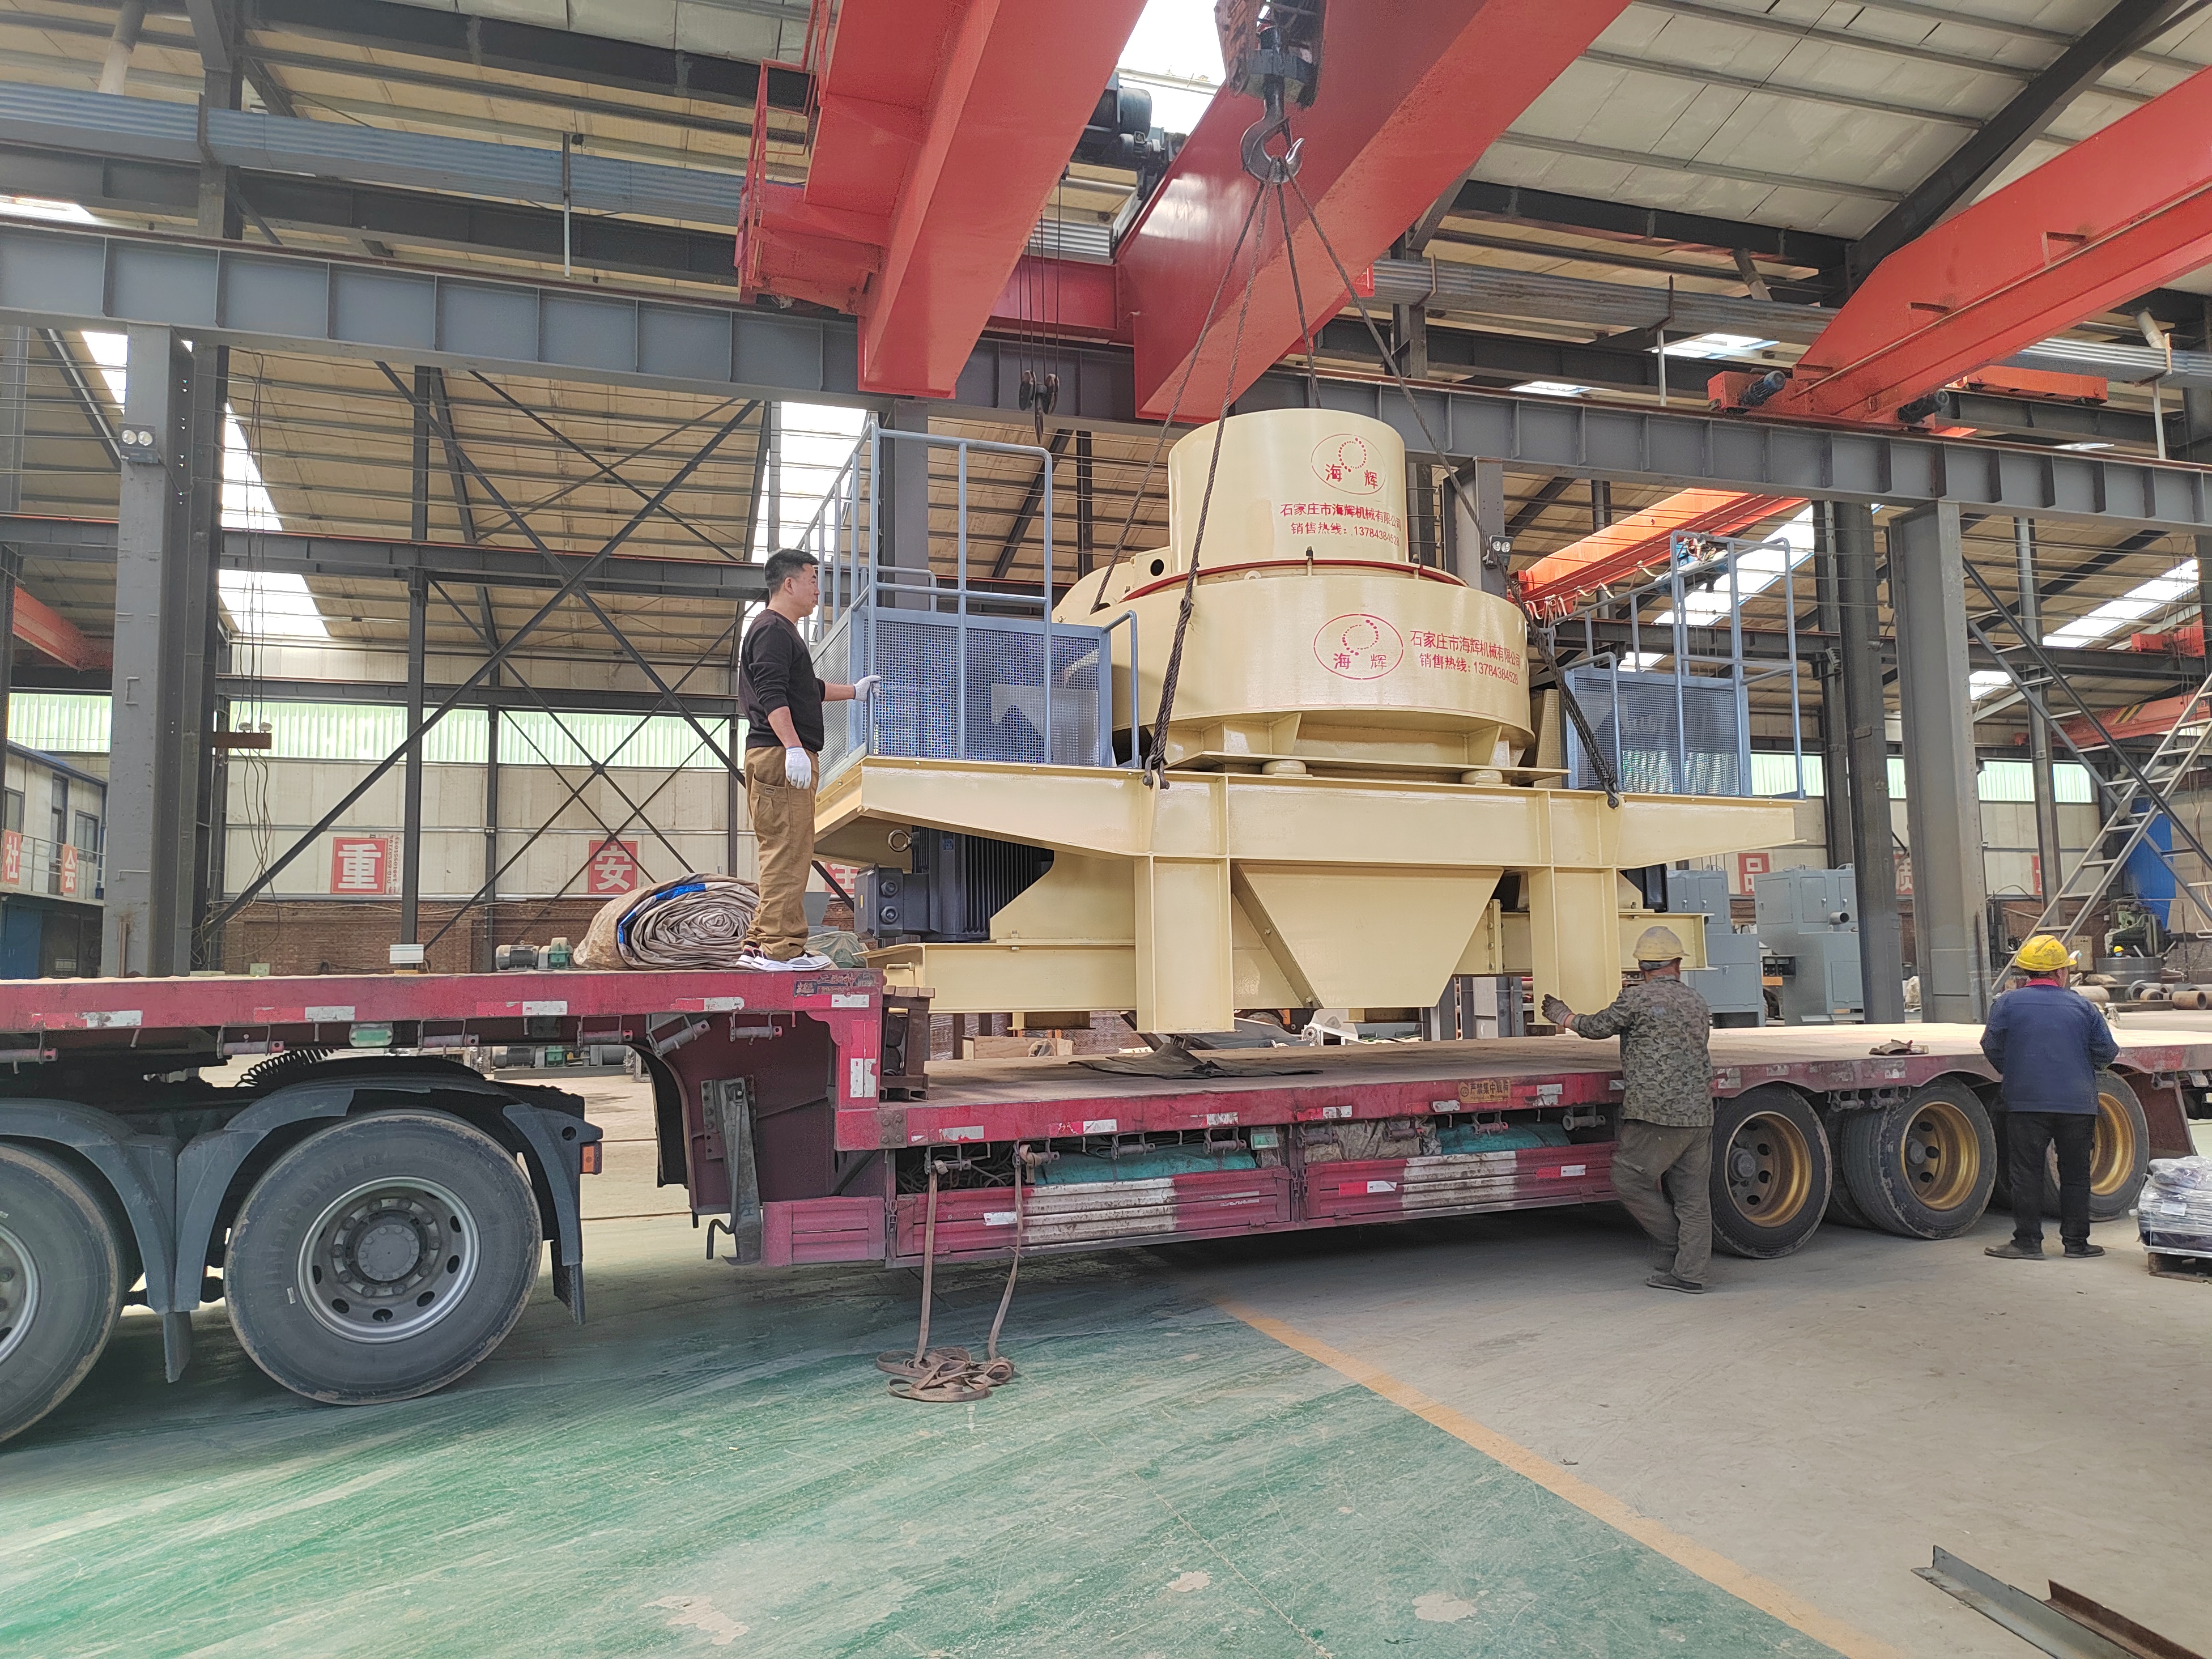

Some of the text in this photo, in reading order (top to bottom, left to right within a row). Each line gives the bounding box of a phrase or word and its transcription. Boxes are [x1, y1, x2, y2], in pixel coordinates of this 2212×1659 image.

[1325, 463, 1379, 489] 海 辉
[1280, 502, 1402, 531] 石家庄市海辉机械有限公司
[1333, 653, 1387, 670] 海 辉
[1409, 630, 1521, 667] 石家庄市海辉机械有限公司
[5, 836, 19, 880] 社
[65, 849, 76, 890] 会
[338, 843, 381, 890] 重
[594, 845, 632, 891] 安
[1743, 858, 1763, 892] 品
